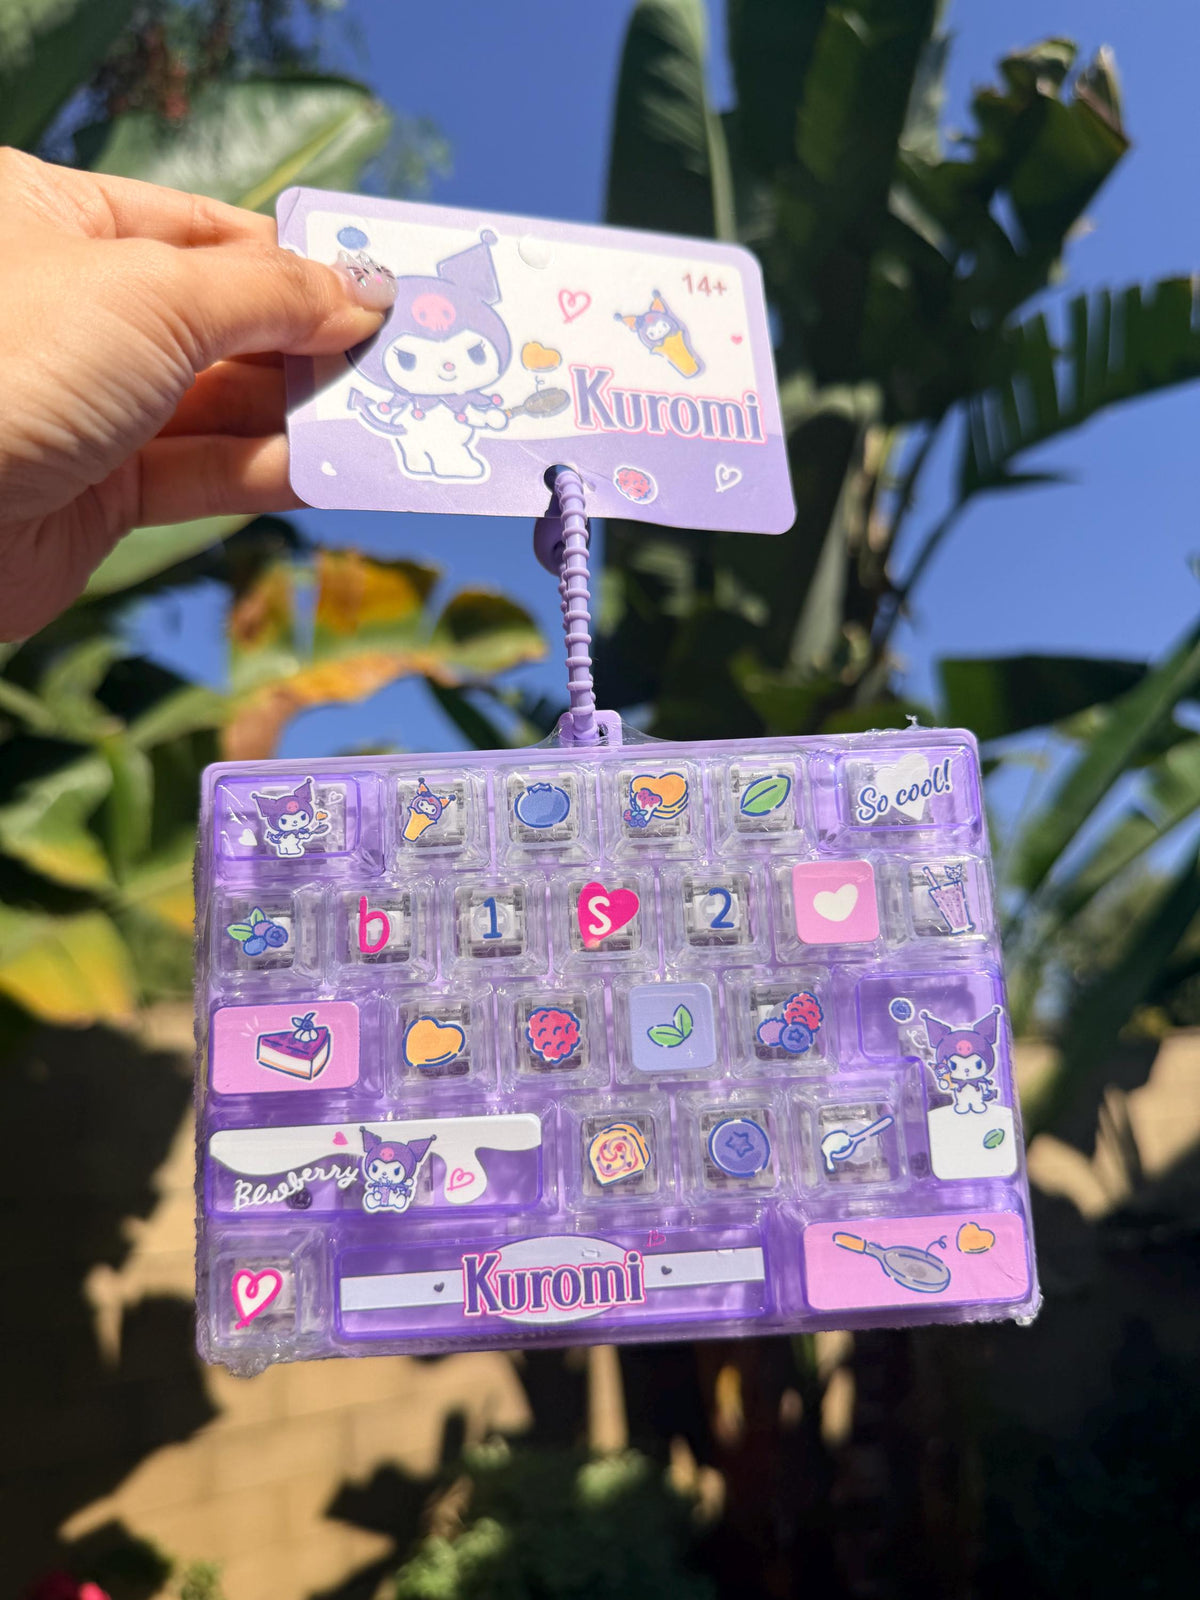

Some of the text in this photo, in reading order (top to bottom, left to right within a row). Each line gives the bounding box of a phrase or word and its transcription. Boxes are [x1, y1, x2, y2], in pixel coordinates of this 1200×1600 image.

[682, 273, 727, 297] 14+
[570, 365, 766, 443] Kuromi
[858, 758, 951, 821] So cool!
[359, 895, 391, 954] b
[482, 896, 503, 939] 1
[708, 886, 735, 929] 2
[232, 1163, 360, 1212] Blueberry
[462, 1250, 646, 1315] Kuromi
